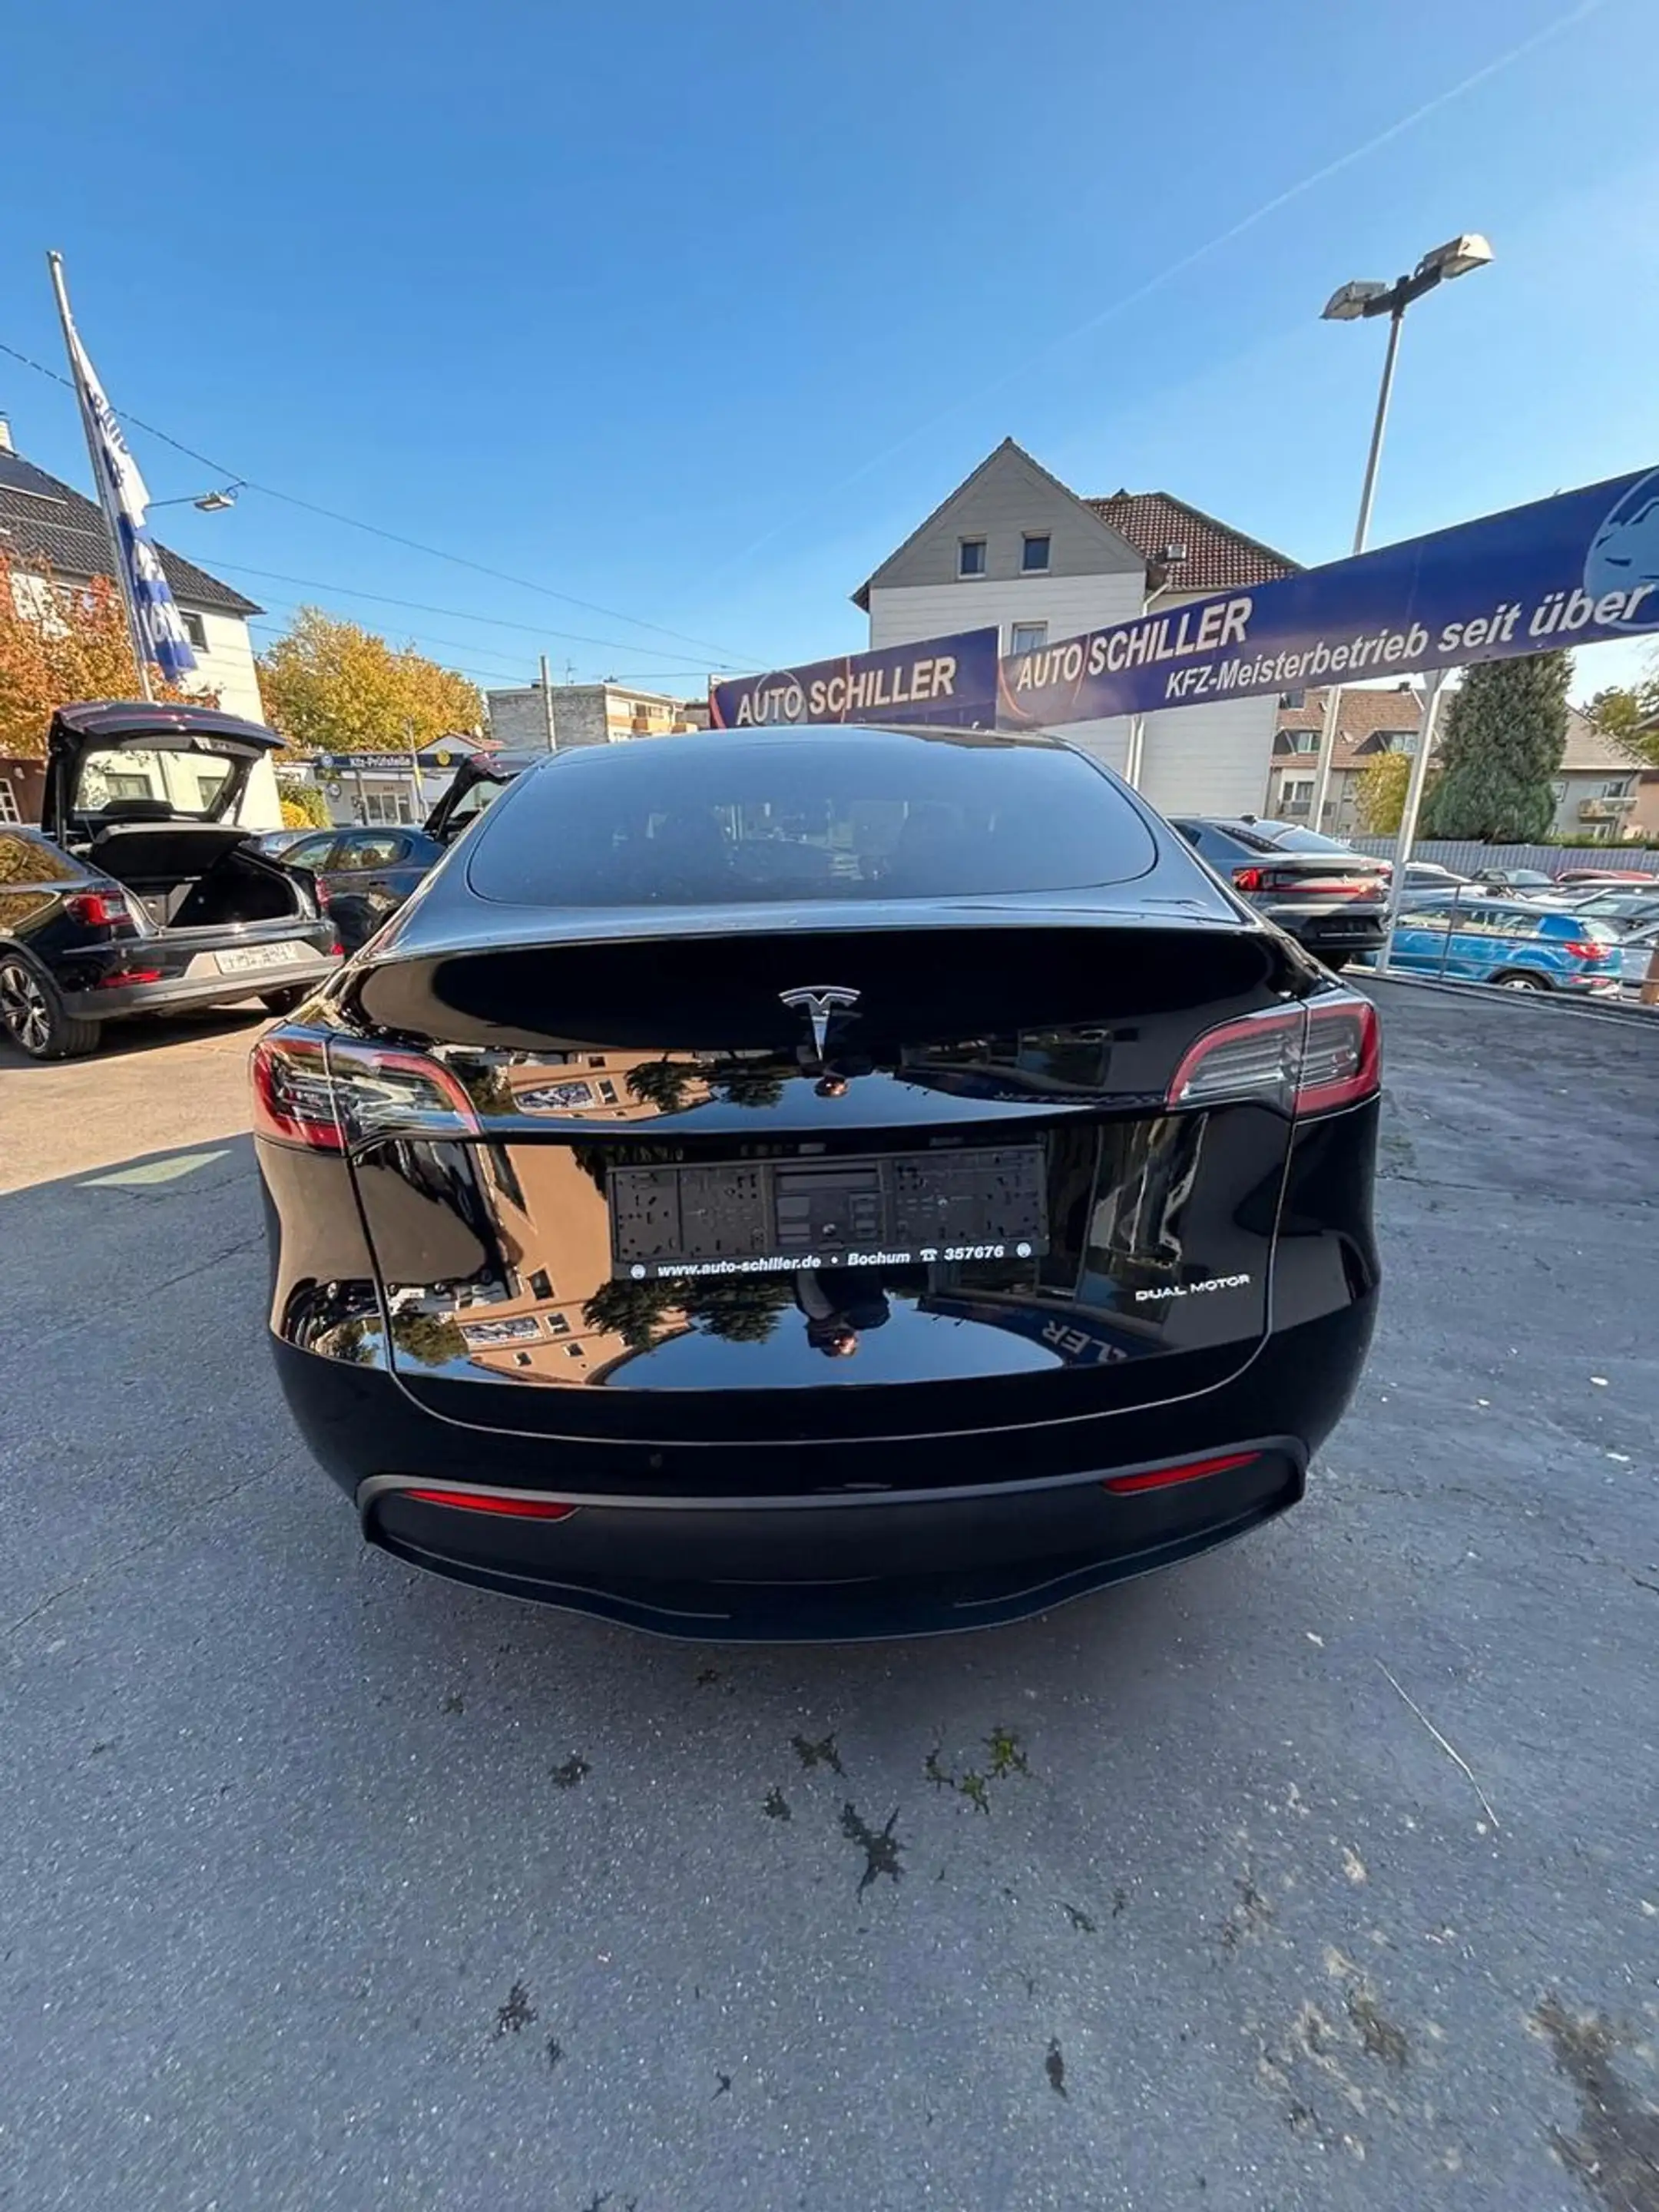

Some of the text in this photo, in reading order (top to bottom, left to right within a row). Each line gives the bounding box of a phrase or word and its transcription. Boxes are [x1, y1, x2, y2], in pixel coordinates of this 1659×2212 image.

[1017, 598, 1253, 691] AUTO SCHILLER
[1165, 583, 1656, 700] KFZ-Meisterbetrieb seit über
[737, 657, 956, 726] AUTO SCHILLER
[657, 1245, 1005, 1277] www.auto-schiller.de Bochum 357676
[1135, 1273, 1250, 1302] DUAL MOTOR
